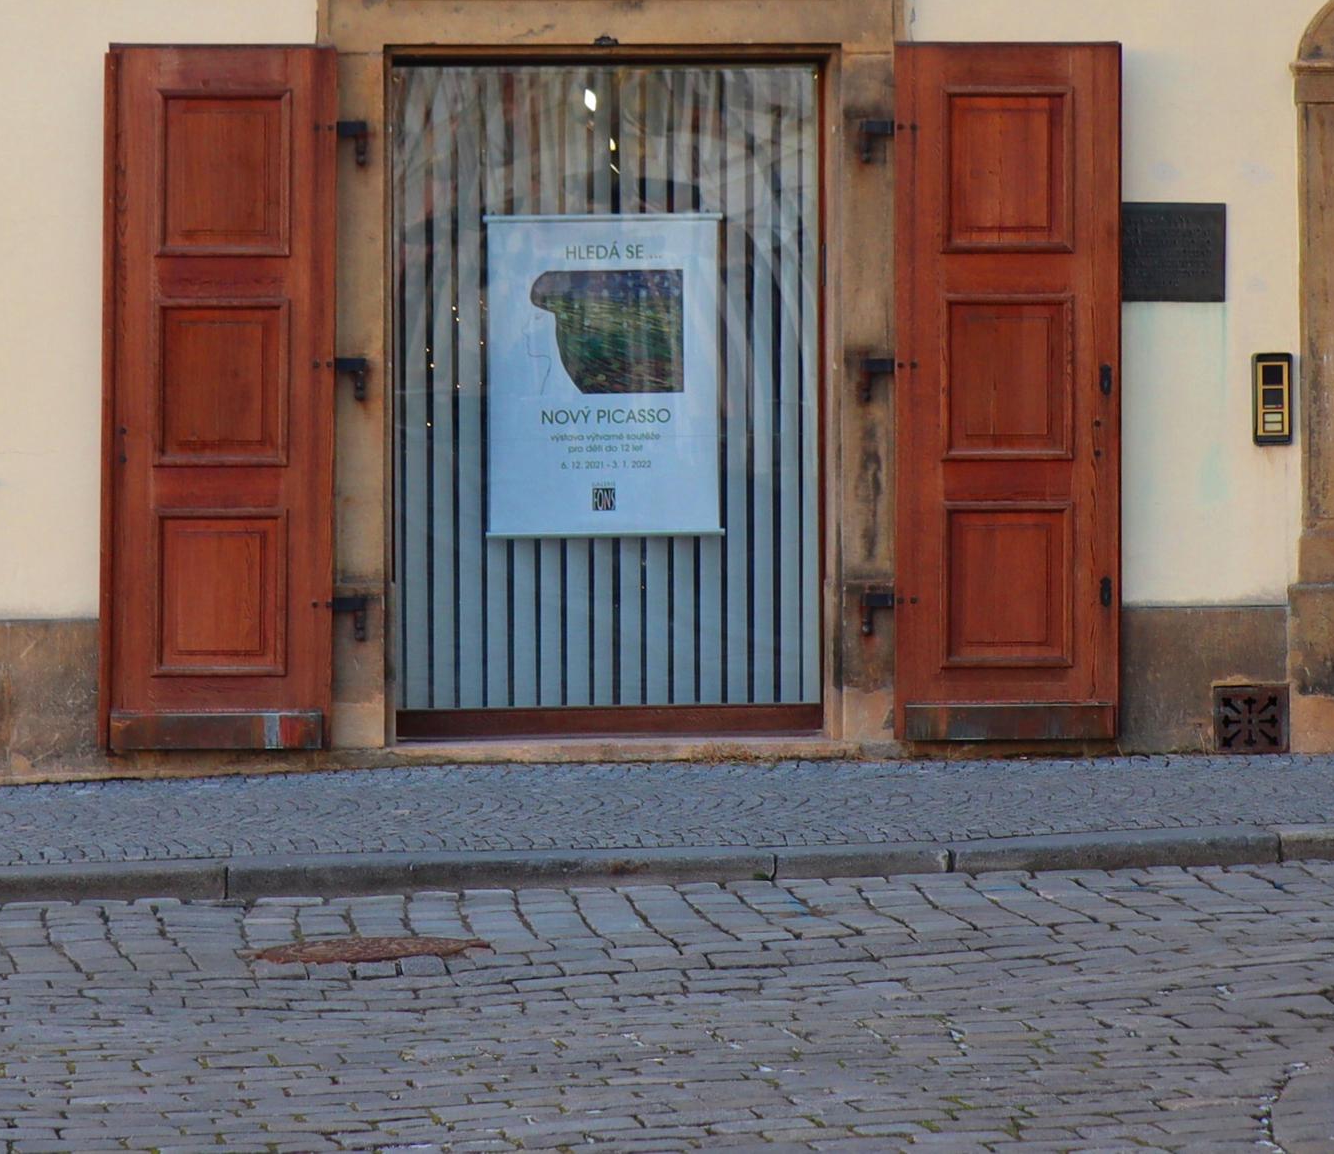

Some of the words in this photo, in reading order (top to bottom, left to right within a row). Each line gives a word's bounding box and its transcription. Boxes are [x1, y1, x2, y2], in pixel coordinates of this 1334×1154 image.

[565, 240, 620, 260] HLEDÁ
[625, 244, 644, 259] SE
[541, 406, 591, 425] NOVÝ
[596, 408, 671, 424] PICASSO
[605, 444, 618, 452] do
[621, 444, 630, 452] 12
[632, 444, 643, 452] let
[632, 460, 652, 468] 2022
[592, 487, 616, 511] FONS
